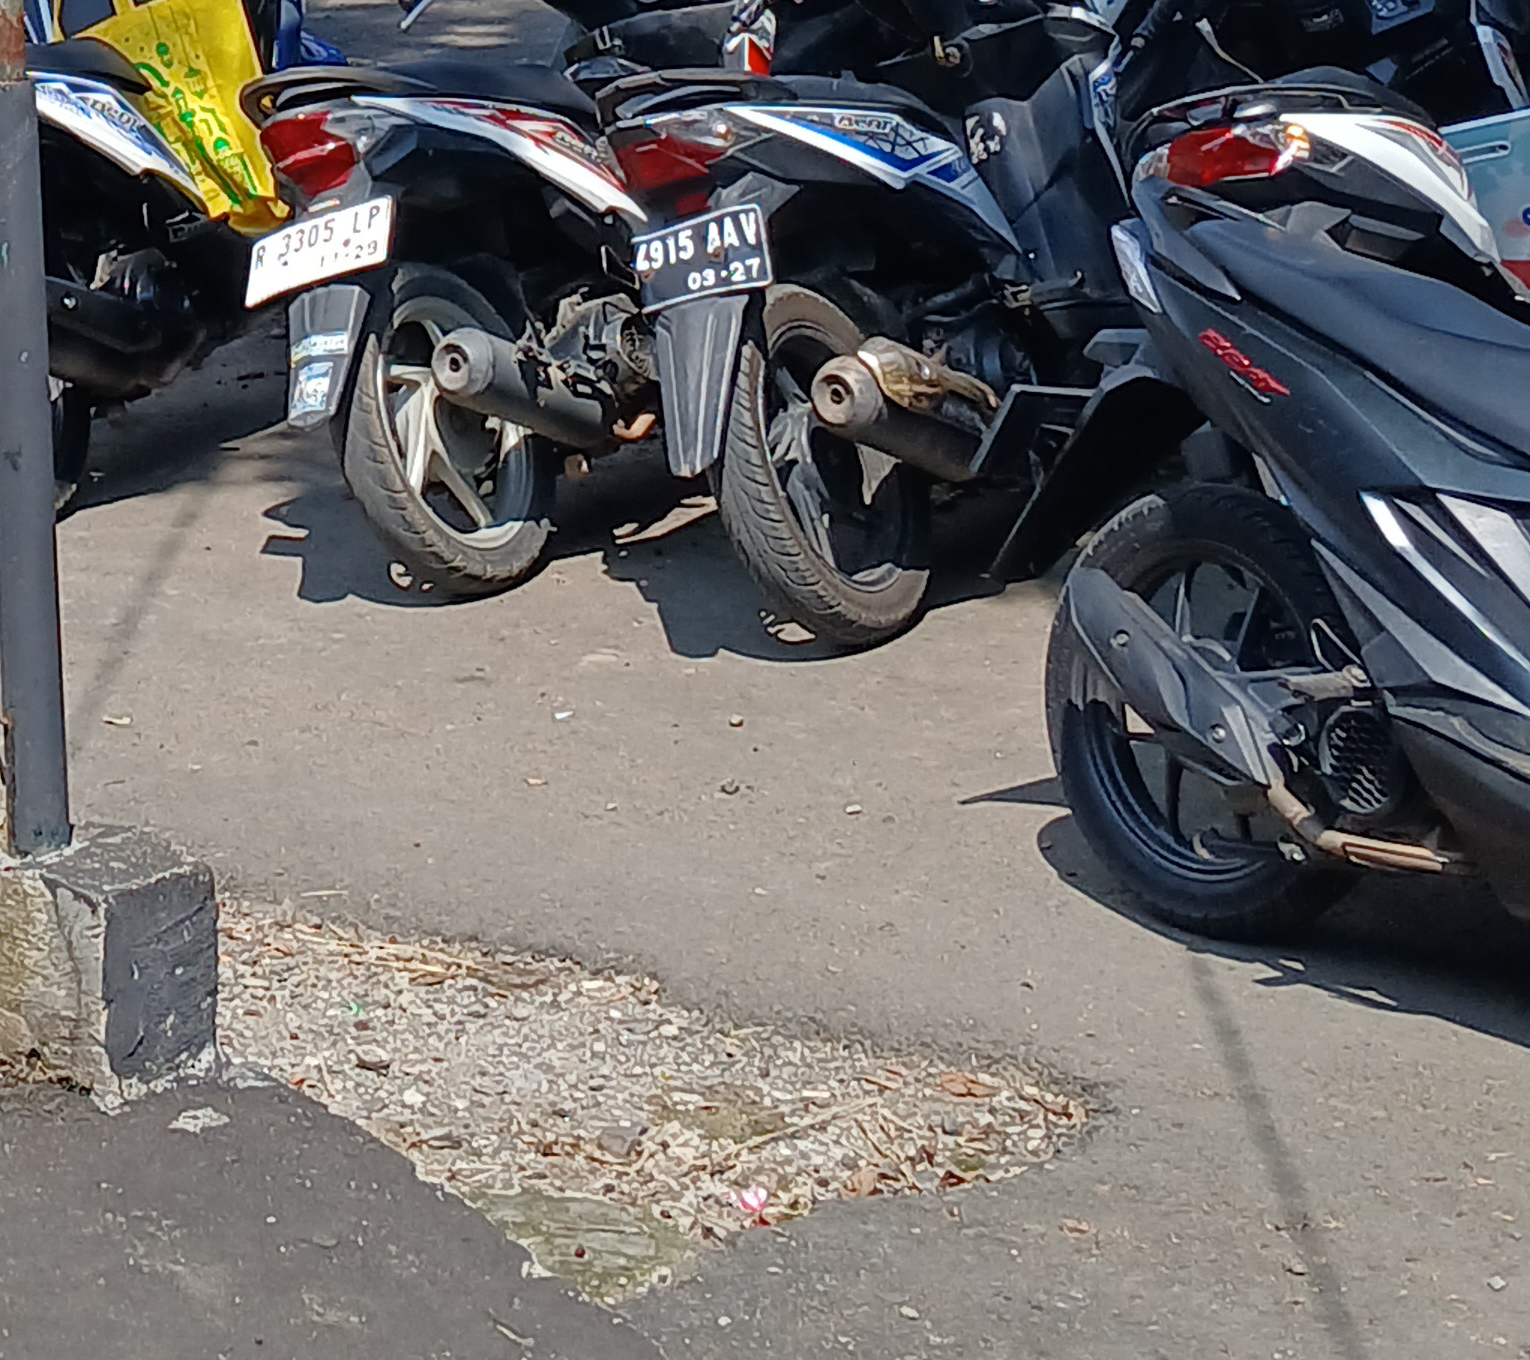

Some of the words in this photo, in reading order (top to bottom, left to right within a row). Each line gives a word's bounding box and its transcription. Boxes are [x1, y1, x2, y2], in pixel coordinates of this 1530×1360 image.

[255, 245, 266, 270] R
[278, 218, 336, 263] 3305
[353, 205, 381, 234] LP
[706, 212, 757, 254] AAV
